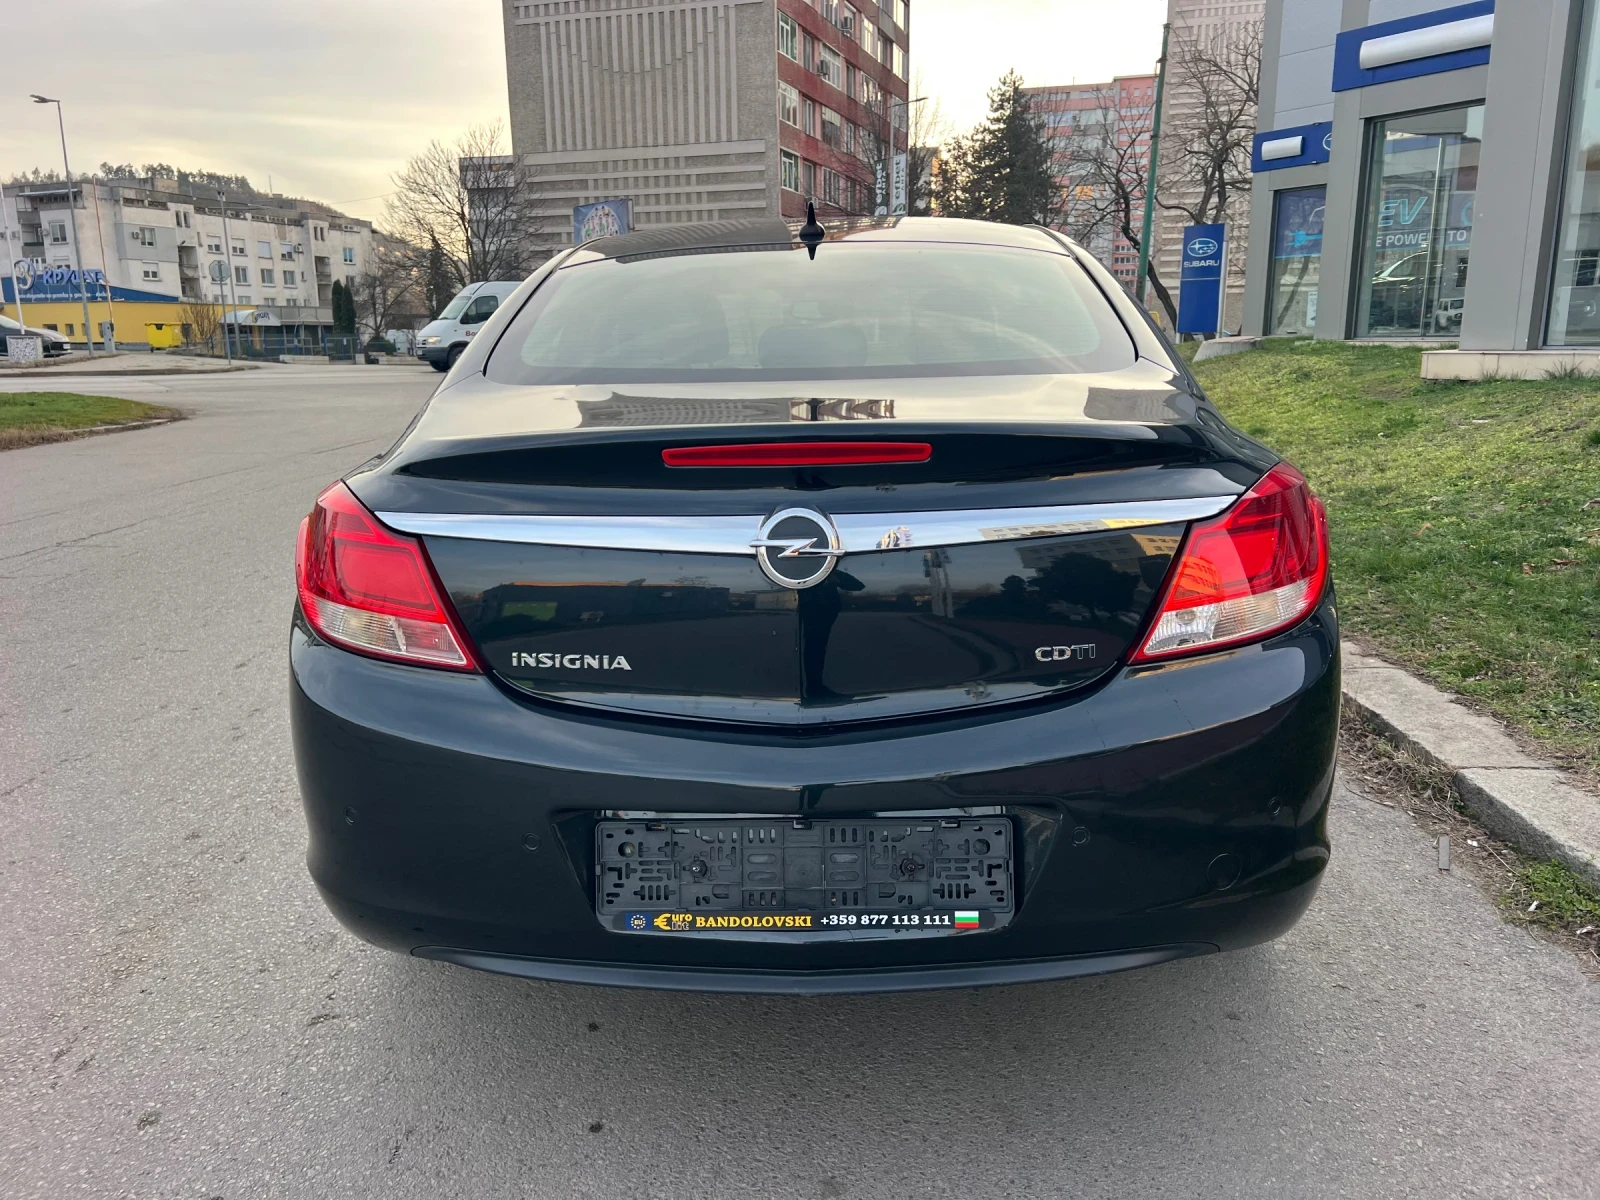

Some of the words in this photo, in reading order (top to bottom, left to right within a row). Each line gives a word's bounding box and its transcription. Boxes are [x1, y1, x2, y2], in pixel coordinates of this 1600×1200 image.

[875, 162, 883, 205] efbet
[1447, 229, 1467, 242] TO
[1183, 259, 1220, 268] SUBARU
[1034, 643, 1096, 662] CDTI
[511, 652, 632, 671] INSIGNIA
[695, 915, 812, 928] BANDOLOVSKI
[820, 914, 857, 926] +359
[860, 914, 888, 926] 877
[891, 914, 920, 926] 113
[923, 914, 951, 926] 111
